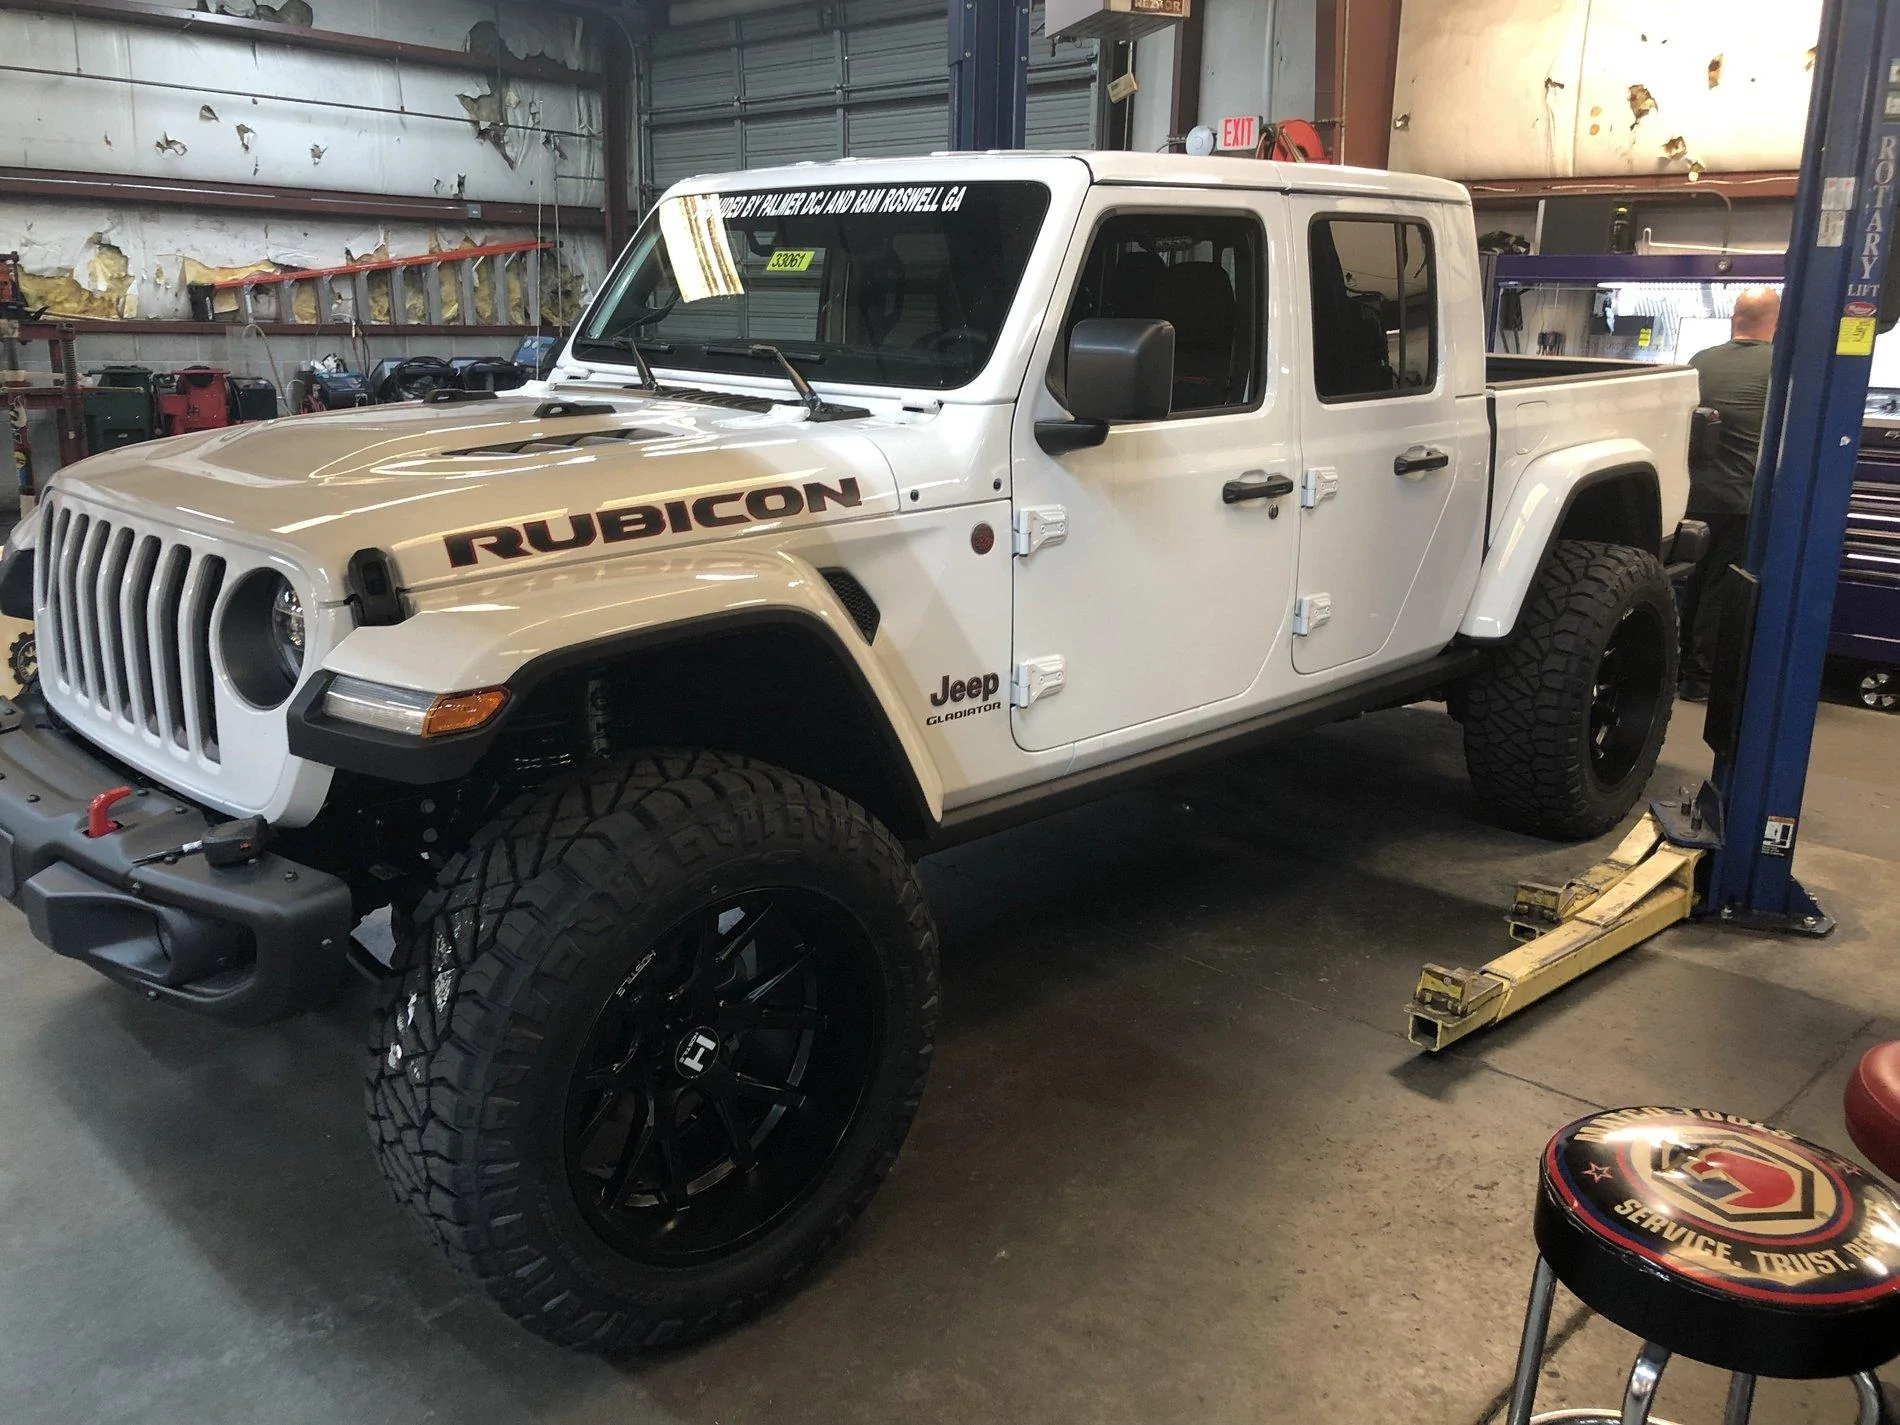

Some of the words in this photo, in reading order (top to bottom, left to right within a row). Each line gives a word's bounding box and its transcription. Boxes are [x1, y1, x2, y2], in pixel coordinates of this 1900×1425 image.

[1223, 117, 1254, 147] EXIT
[740, 195, 765, 217] BY
[757, 193, 807, 217] PALMER
[800, 191, 832, 215] DCJ
[823, 190, 856, 214] AND
[850, 189, 887, 213] RAM
[879, 186, 944, 213] ROSWELL
[941, 186, 968, 212] GA
[1860, 136, 1896, 281] ROTARY
[771, 253, 806, 268] 33061
[1847, 284, 1880, 297] LIFT
[443, 476, 863, 568] RUBICON
[930, 672, 1000, 707] Jeep
[926, 701, 1001, 726] GLADIATOR
[1613, 1198, 1742, 1267] SERVICE.
[1749, 1249, 1857, 1275] TRUST.
